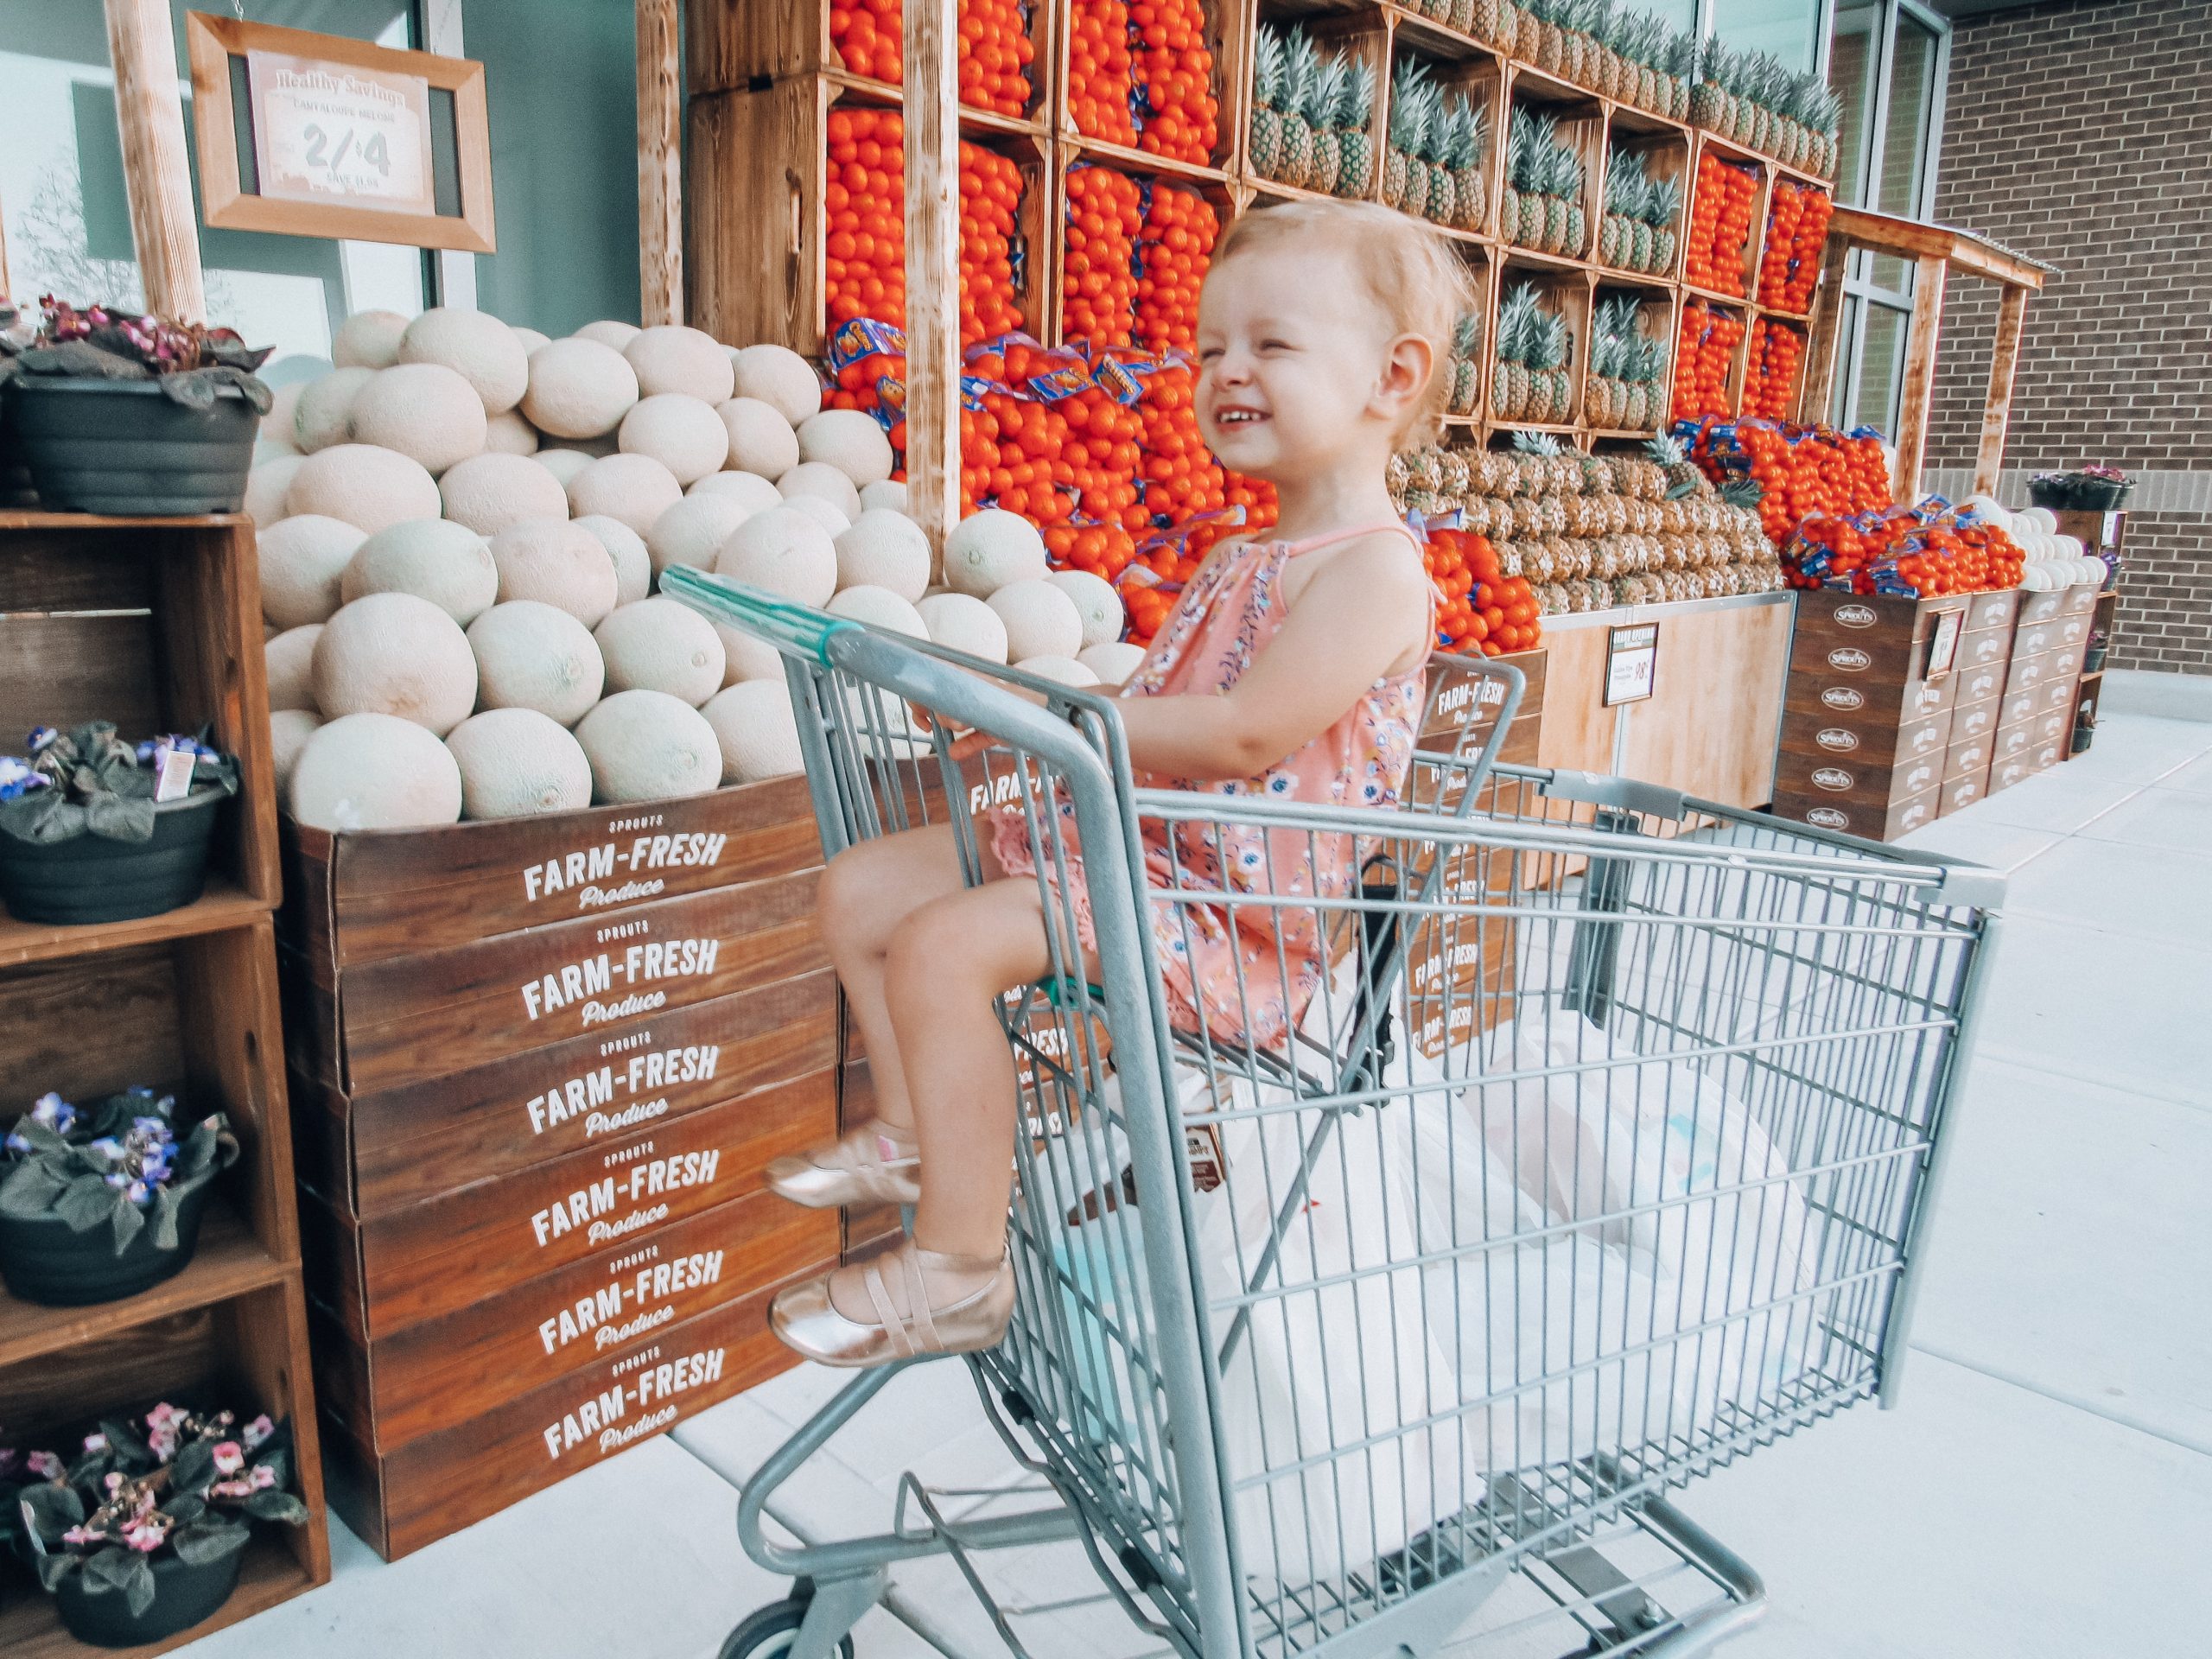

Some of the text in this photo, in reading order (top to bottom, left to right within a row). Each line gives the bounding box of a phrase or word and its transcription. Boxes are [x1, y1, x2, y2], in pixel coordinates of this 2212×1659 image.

[276, 68, 406, 110] Healthy Savings
[609, 814, 664, 834] SPROUTS
[524, 833, 727, 902] FARM-FRESH
[579, 878, 665, 910] Produce
[597, 919, 649, 944] SPROUTS
[521, 938, 719, 1021] FARM-FRESH
[582, 990, 667, 1027] Produce
[600, 1031, 652, 1057] SPROUTS
[526, 1045, 720, 1135] FARM-FRESH
[585, 1097, 669, 1139] Produce
[604, 1141, 655, 1169] SPROUTS
[531, 1148, 720, 1248] FARM-FRESH
[588, 1203, 670, 1246] Produce
[609, 1244, 659, 1274] SPROUTS
[538, 1249, 724, 1356] FARM-FRESH
[594, 1305, 676, 1351] Produce
[612, 1345, 661, 1377] SPROUTS
[543, 1347, 725, 1460] FARM-FRESH
[599, 1404, 678, 1454] Produce
